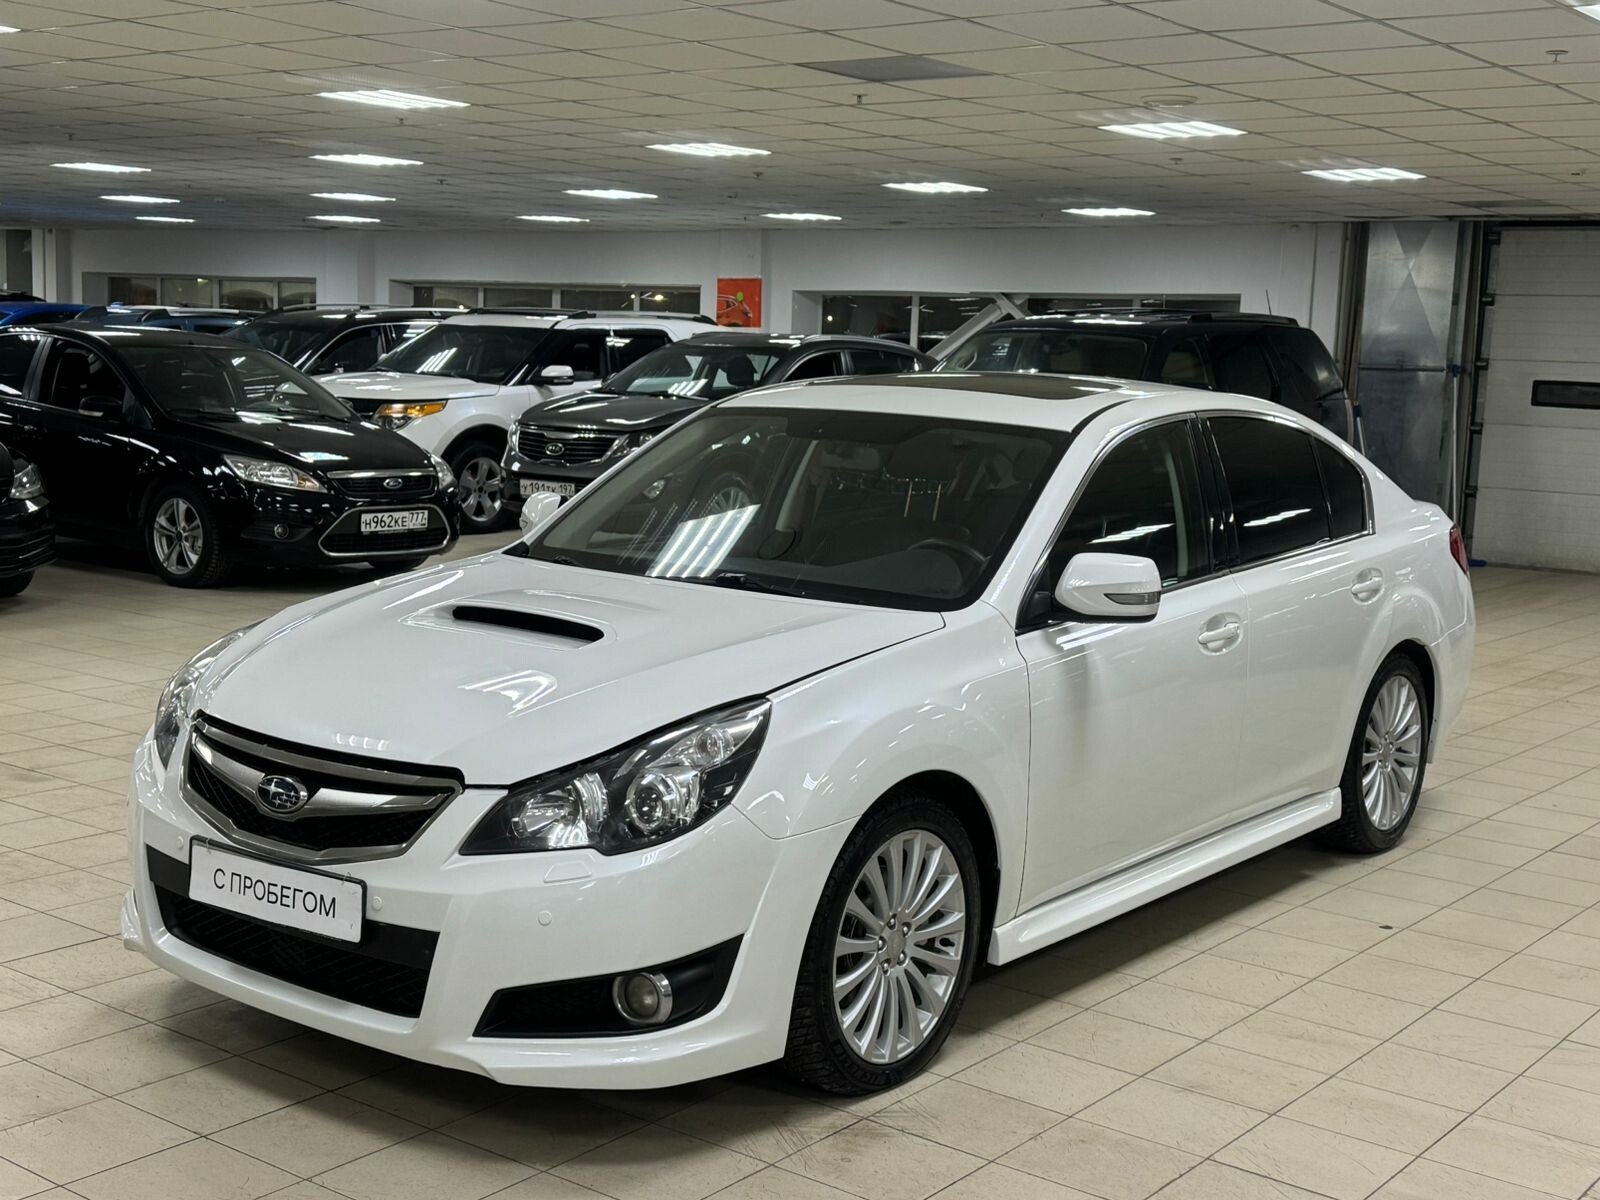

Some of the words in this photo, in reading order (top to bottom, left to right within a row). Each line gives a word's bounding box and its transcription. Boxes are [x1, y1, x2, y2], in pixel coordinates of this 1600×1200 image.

[365, 514, 407, 529] Н962КЕ
[409, 512, 425, 523] 777
[213, 868, 226, 889] С
[230, 872, 336, 918] ПРОБЕГОМ
